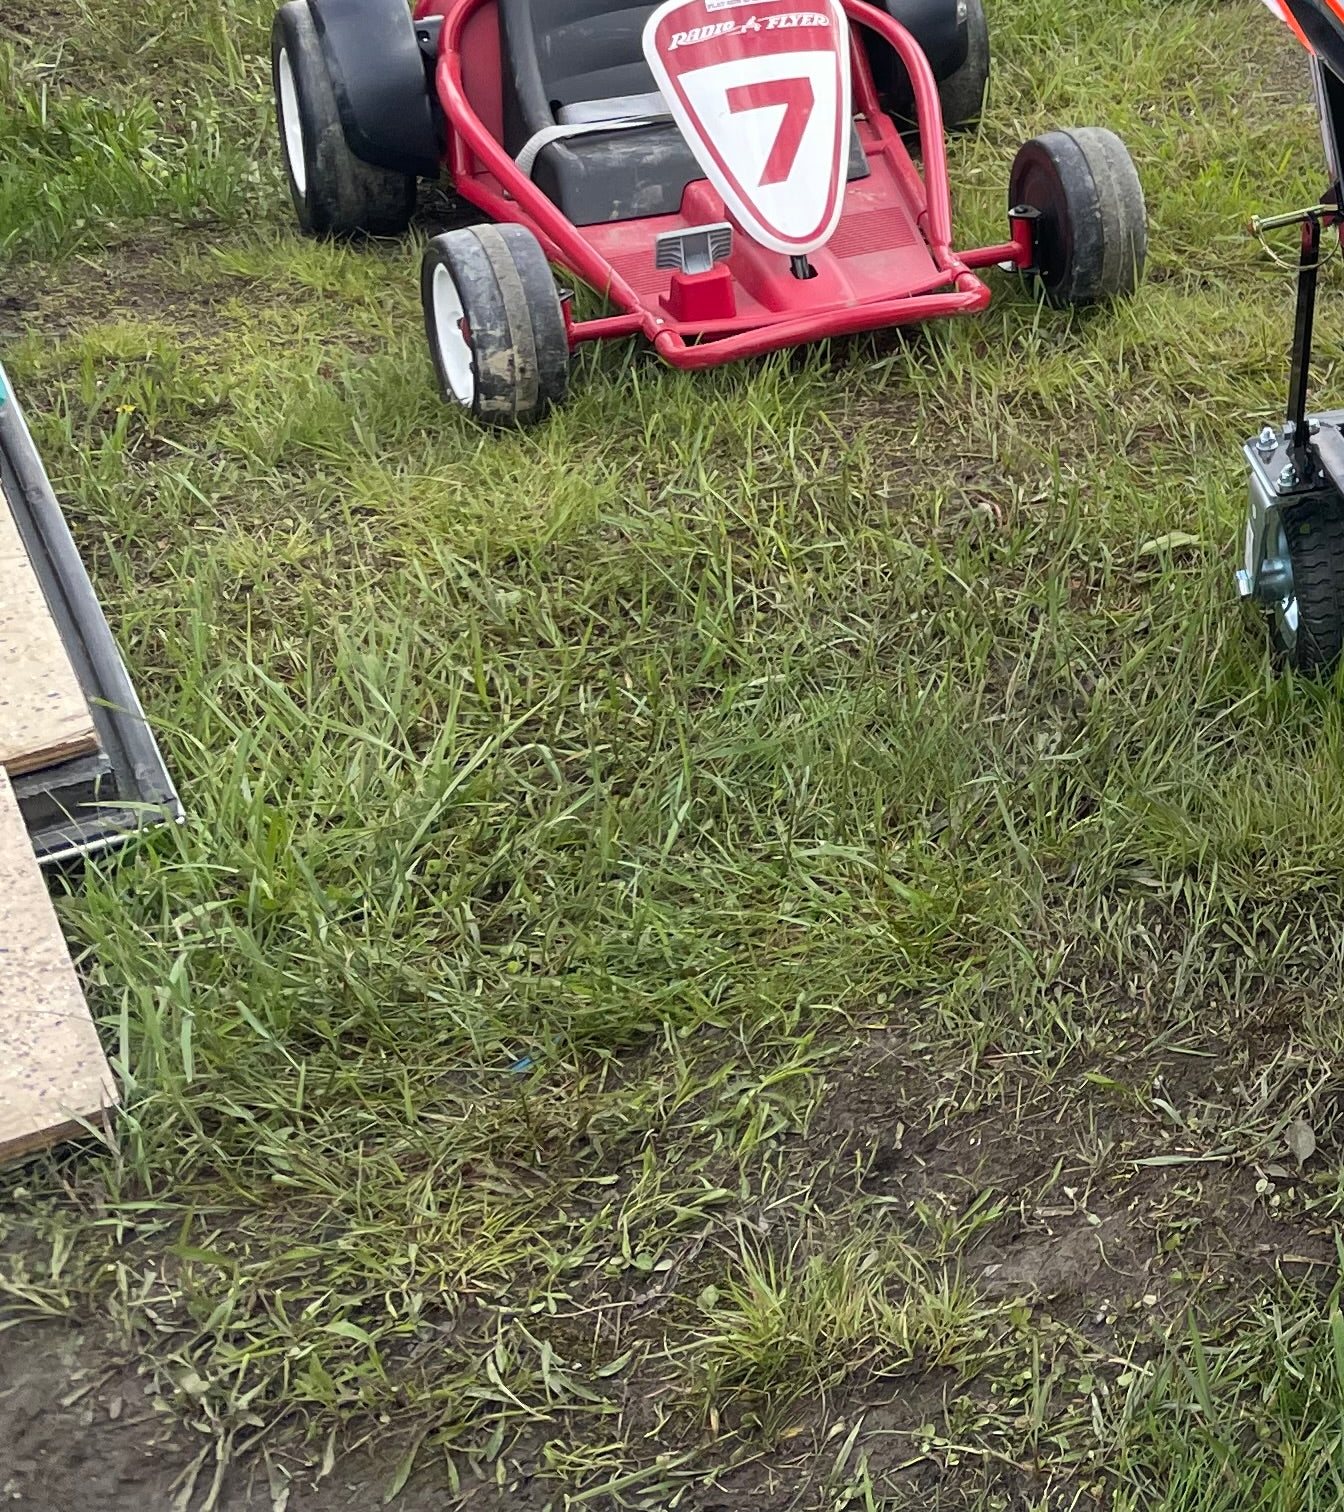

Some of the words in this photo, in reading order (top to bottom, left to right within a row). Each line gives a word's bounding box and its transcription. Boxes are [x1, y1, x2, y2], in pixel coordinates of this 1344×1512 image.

[668, 20, 737, 51] RADIO
[766, 13, 830, 30] FLYER
[726, 76, 817, 187] 7
